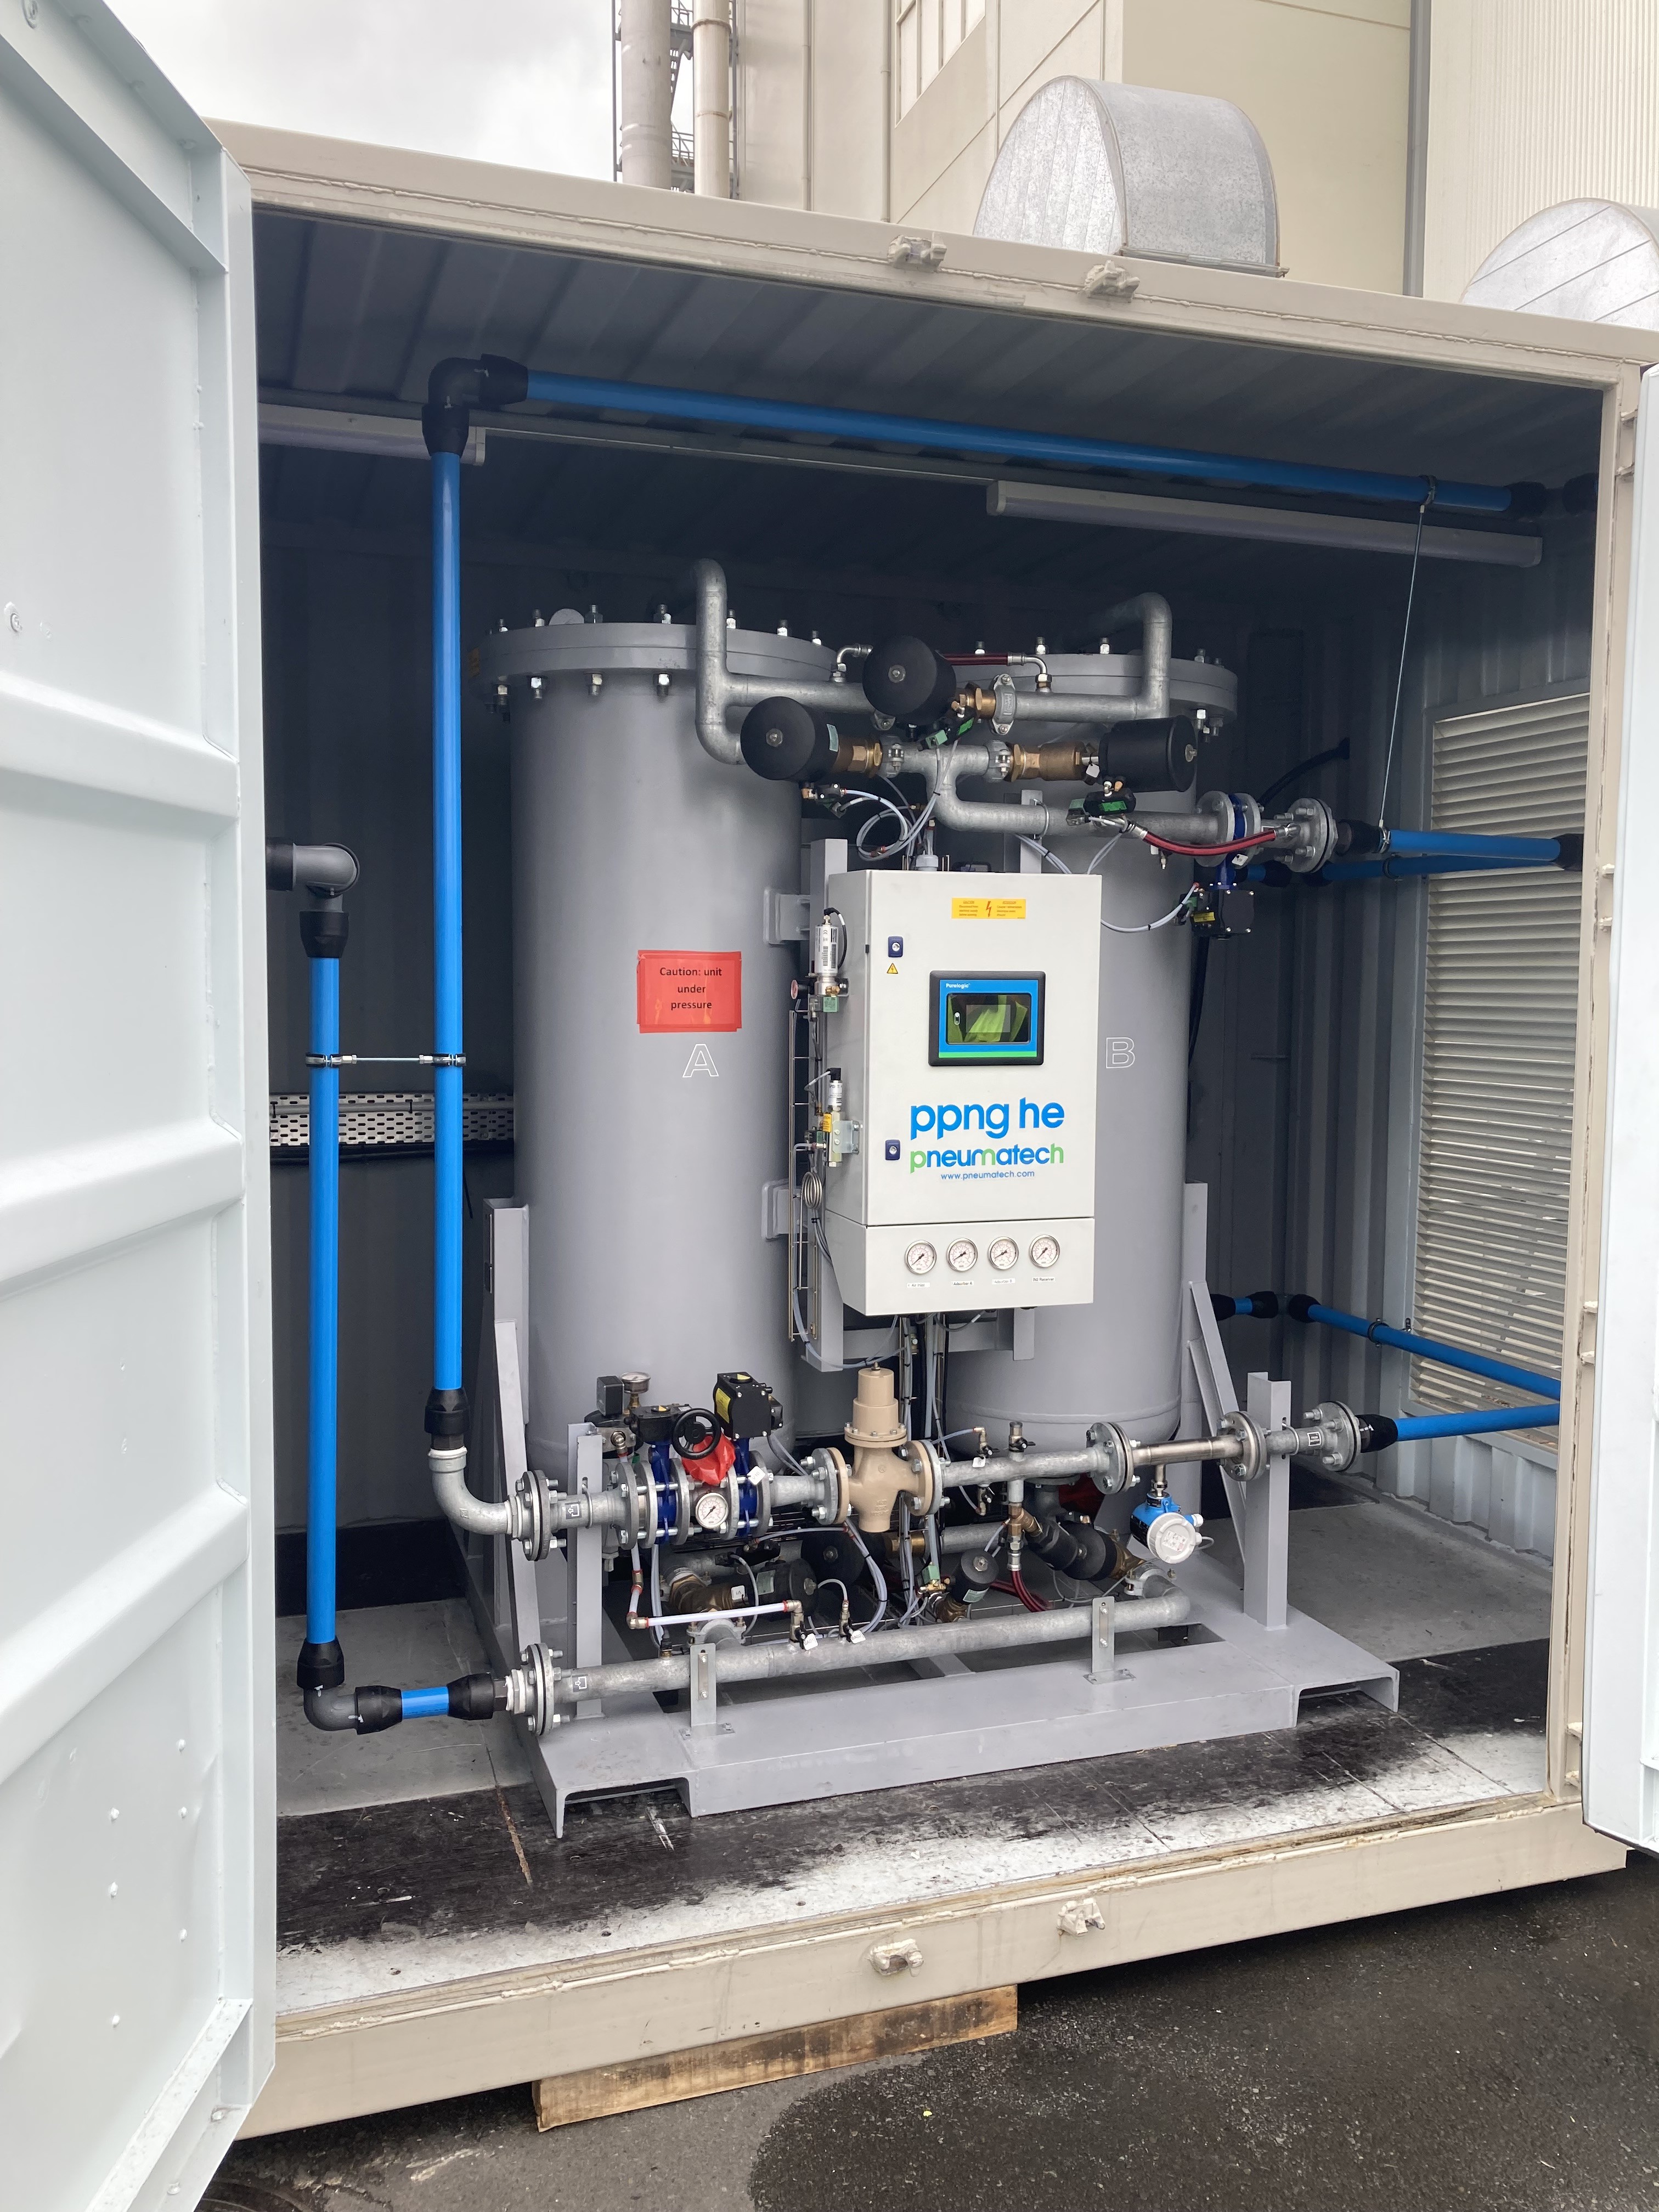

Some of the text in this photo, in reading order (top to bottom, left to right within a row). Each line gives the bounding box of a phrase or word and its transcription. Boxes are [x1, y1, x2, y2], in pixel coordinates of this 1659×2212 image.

[659, 967, 722, 976] Caution: unit
[678, 984, 706, 993] under
[670, 1001, 712, 1011] pressure
[682, 1043, 719, 1078] A
[1106, 1037, 1135, 1069] B
[910, 1097, 1065, 1141] ppng he
[910, 1143, 1064, 1174] pneumatech
[940, 1170, 1035, 1181] www.pneumatech.com
